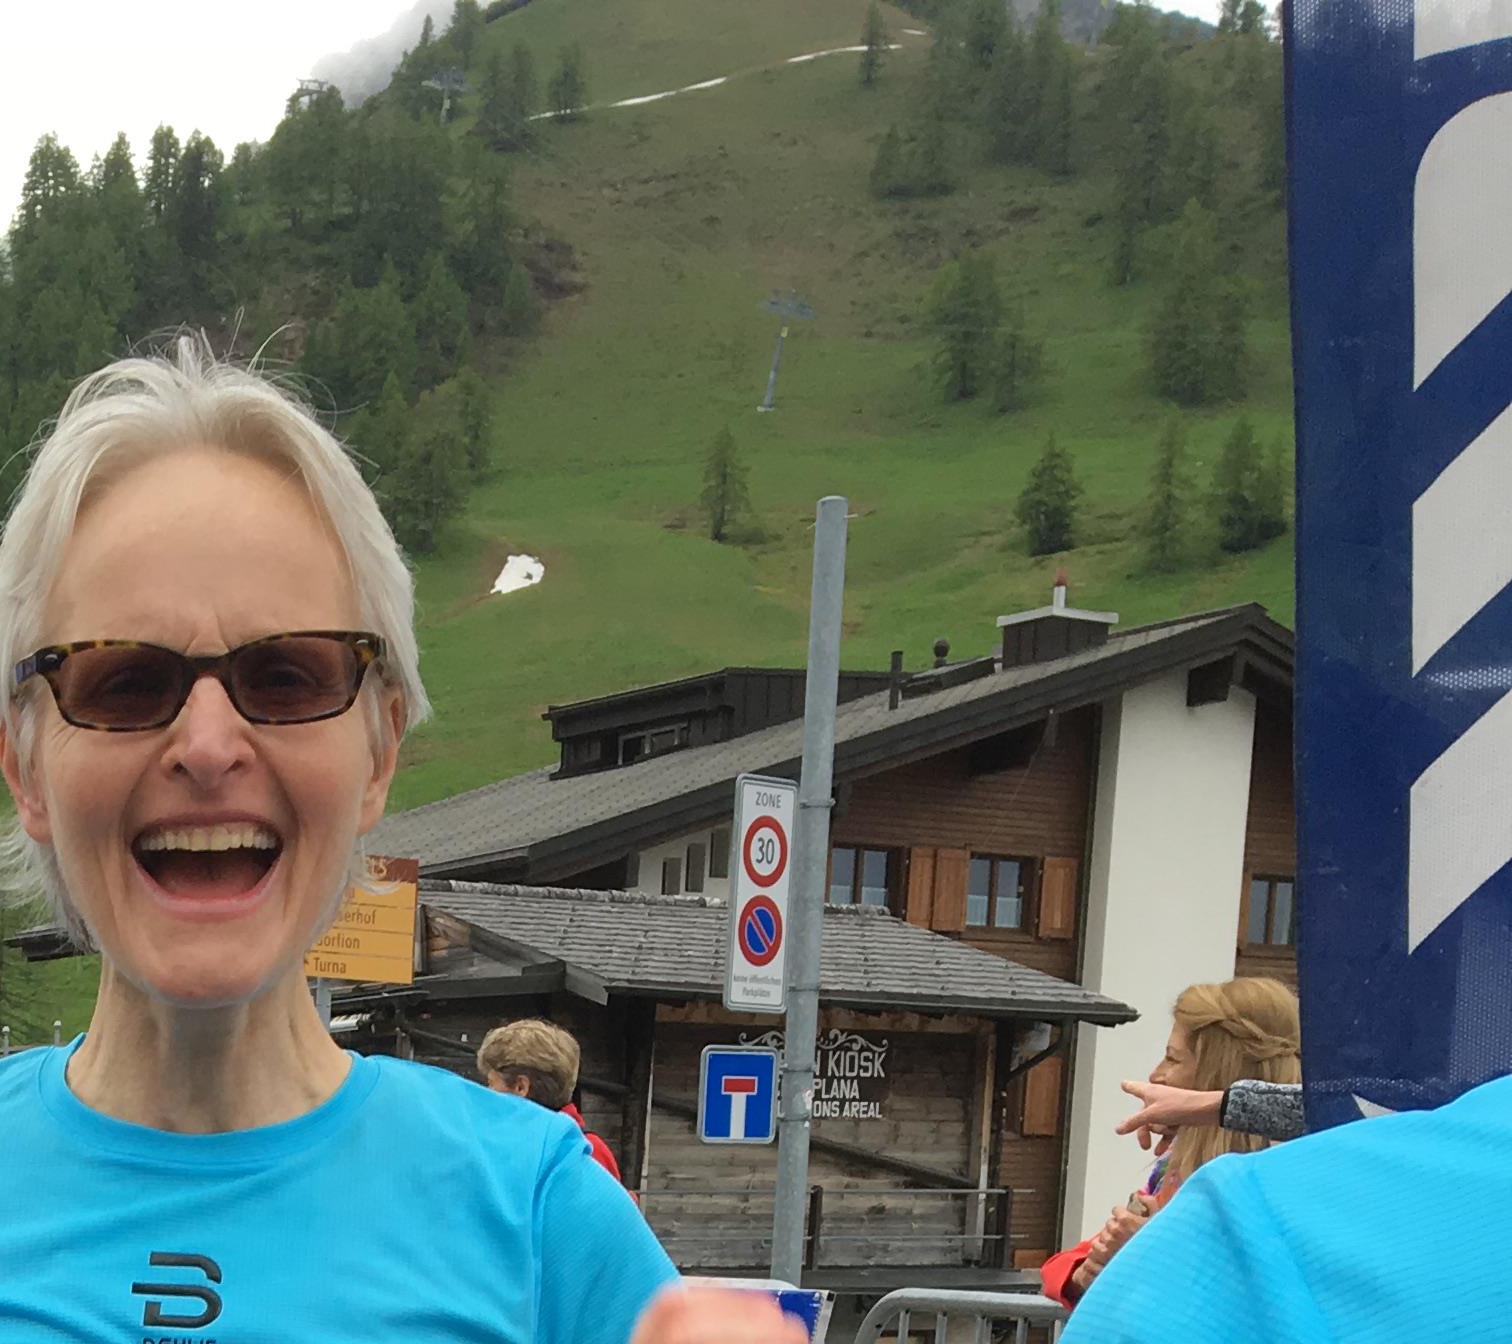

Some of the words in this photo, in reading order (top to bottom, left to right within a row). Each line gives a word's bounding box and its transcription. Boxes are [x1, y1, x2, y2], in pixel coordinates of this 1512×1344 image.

[755, 792, 782, 809] ZONE
[756, 837, 775, 865] 30
[313, 957, 347, 975] Turna
[827, 1051, 886, 1079] KIOSK
[843, 1102, 883, 1119] AREAL
